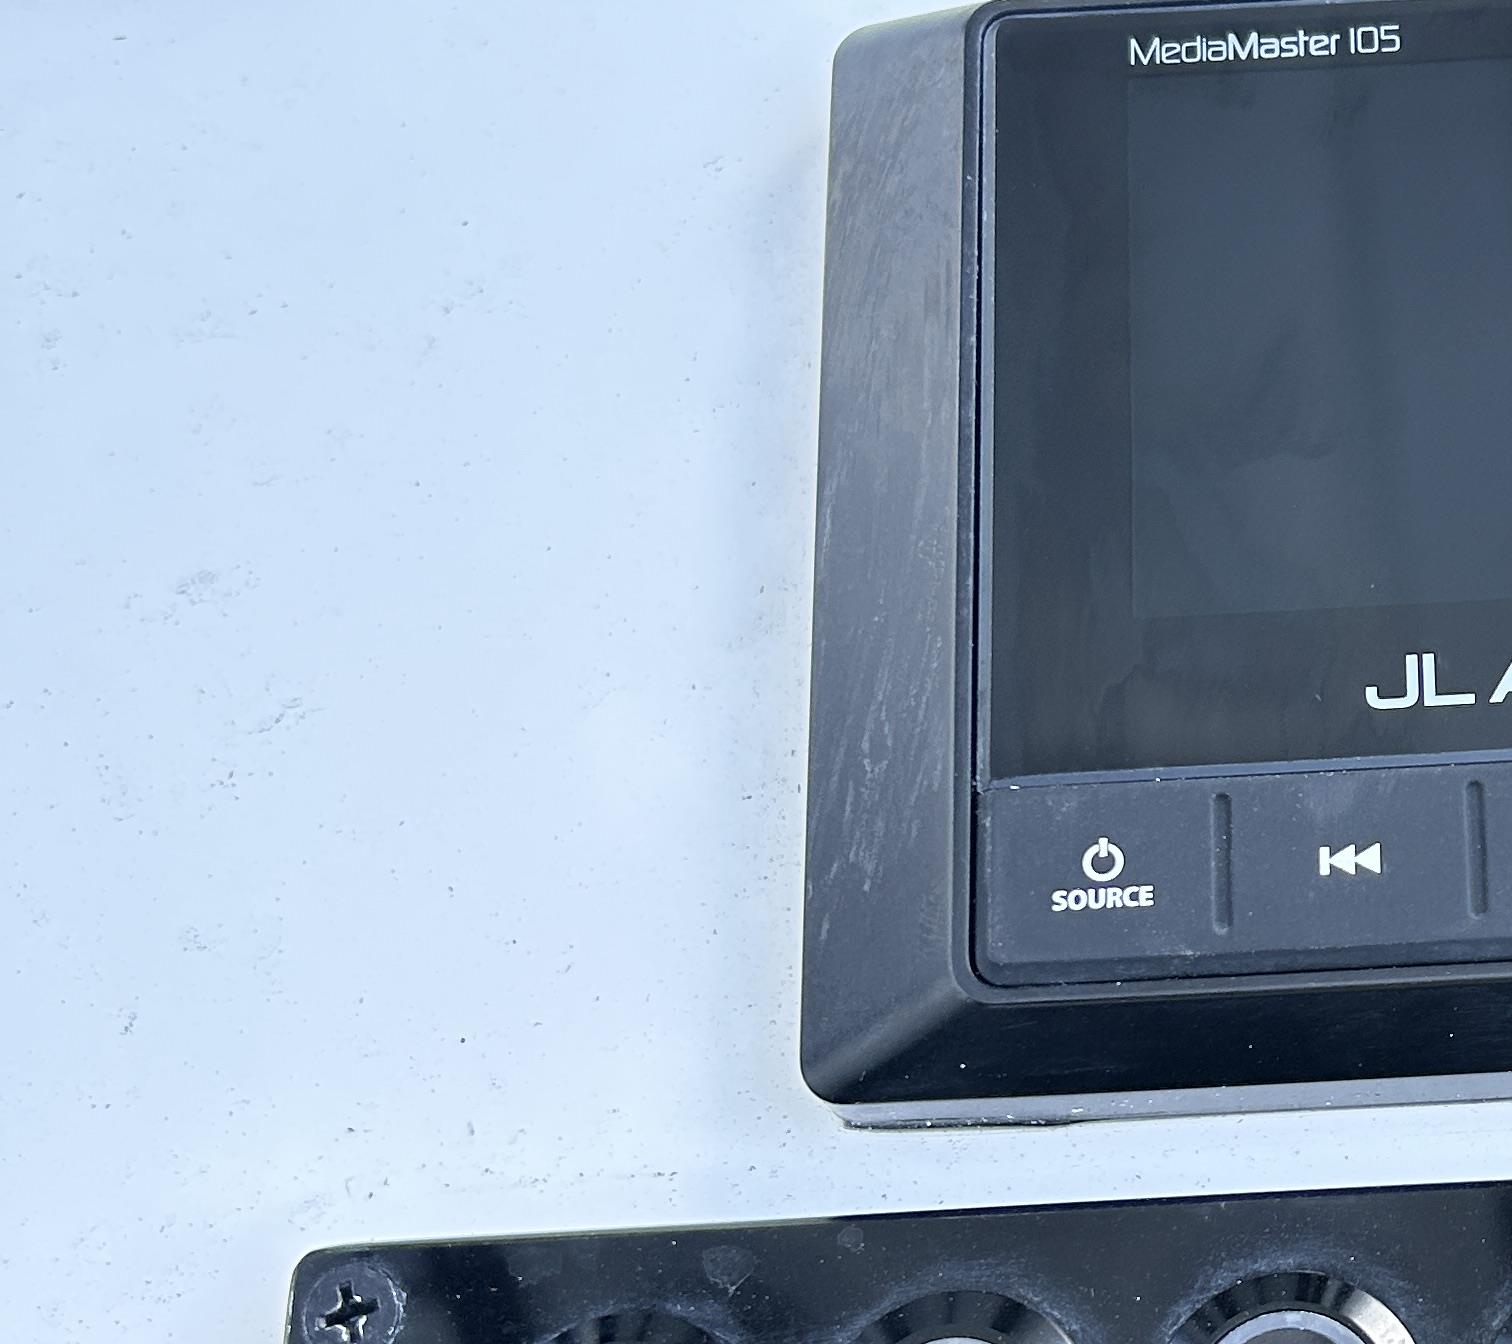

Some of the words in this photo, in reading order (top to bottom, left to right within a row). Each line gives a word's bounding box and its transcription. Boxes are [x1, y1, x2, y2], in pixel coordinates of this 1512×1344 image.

[1130, 29, 1341, 66] MediaMaster
[1349, 24, 1401, 55] 105
[1365, 652, 1476, 710] JL
[1051, 884, 1155, 912] SOURCE
